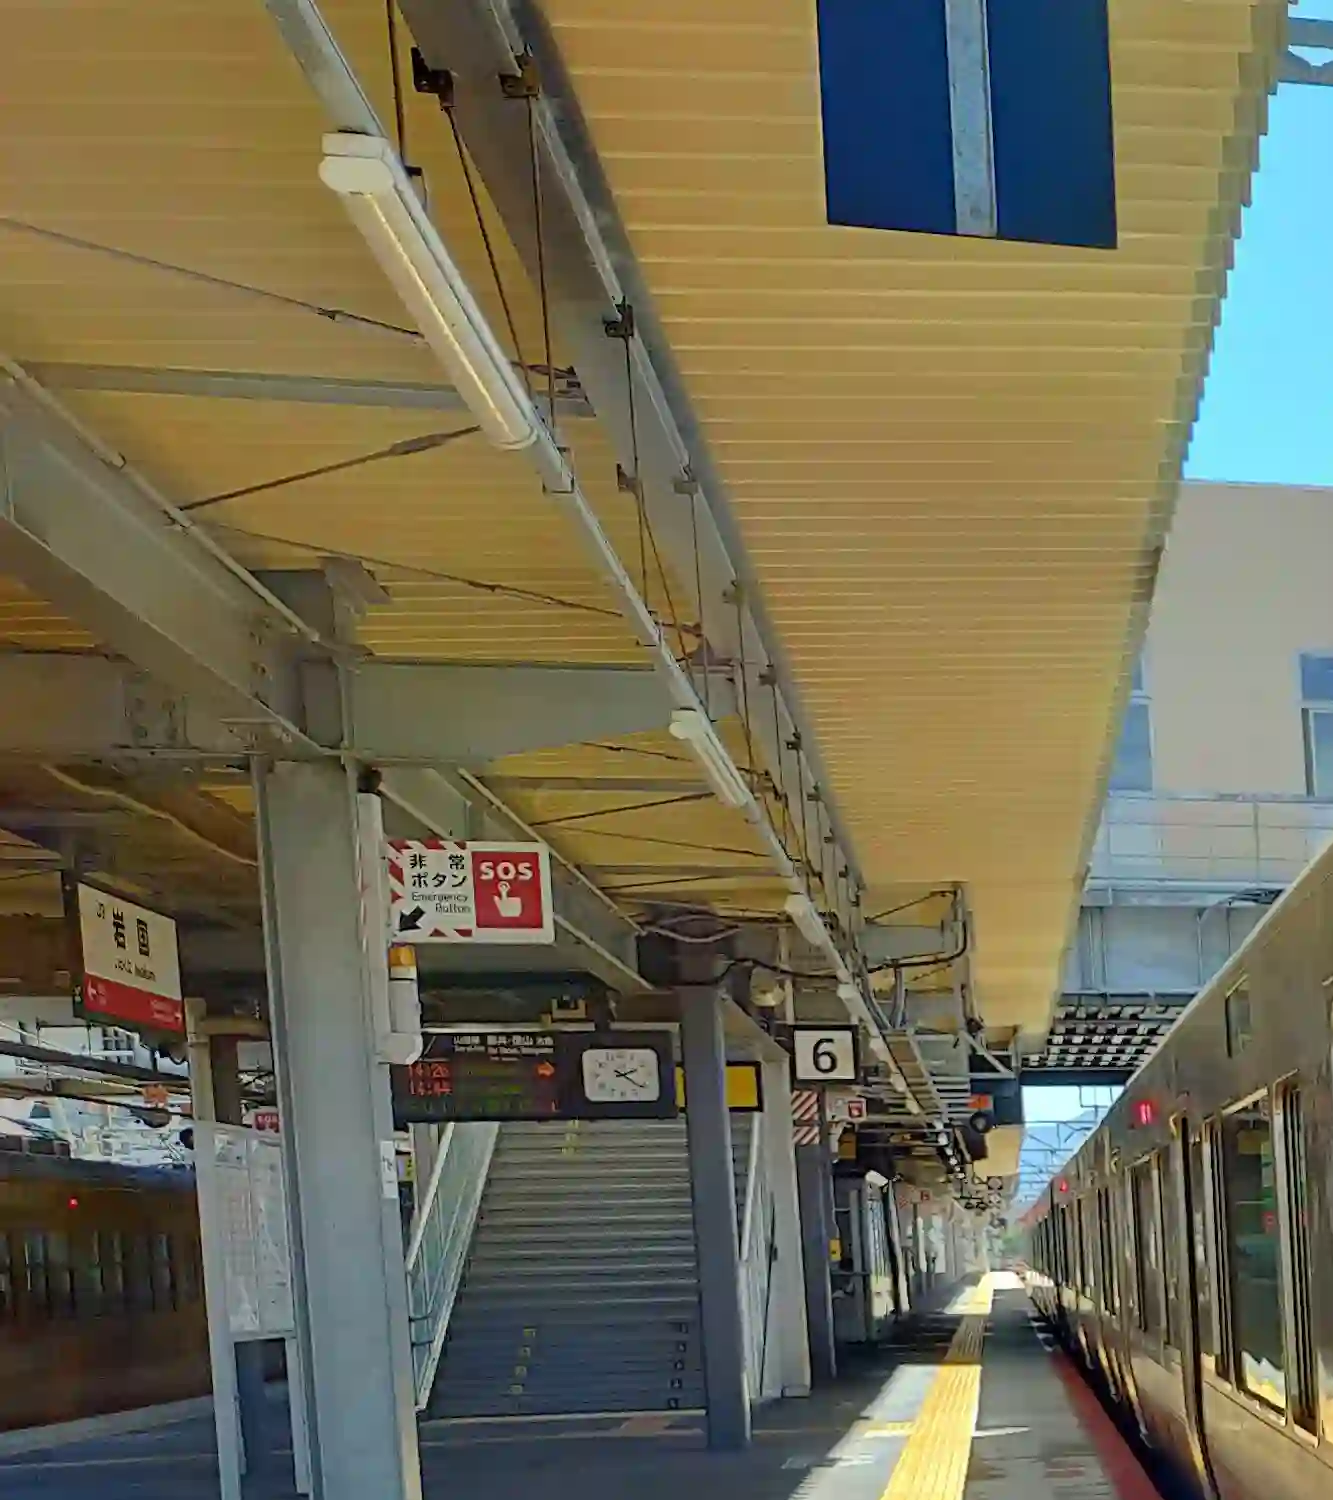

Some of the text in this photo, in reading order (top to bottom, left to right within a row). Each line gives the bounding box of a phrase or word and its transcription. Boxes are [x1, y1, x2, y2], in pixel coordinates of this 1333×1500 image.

[409, 854, 465, 870] 非常
[480, 862, 533, 881] SOS
[411, 892, 468, 903] Emergency
[112, 907, 151, 957] 岩国
[813, 1038, 838, 1074] 6
